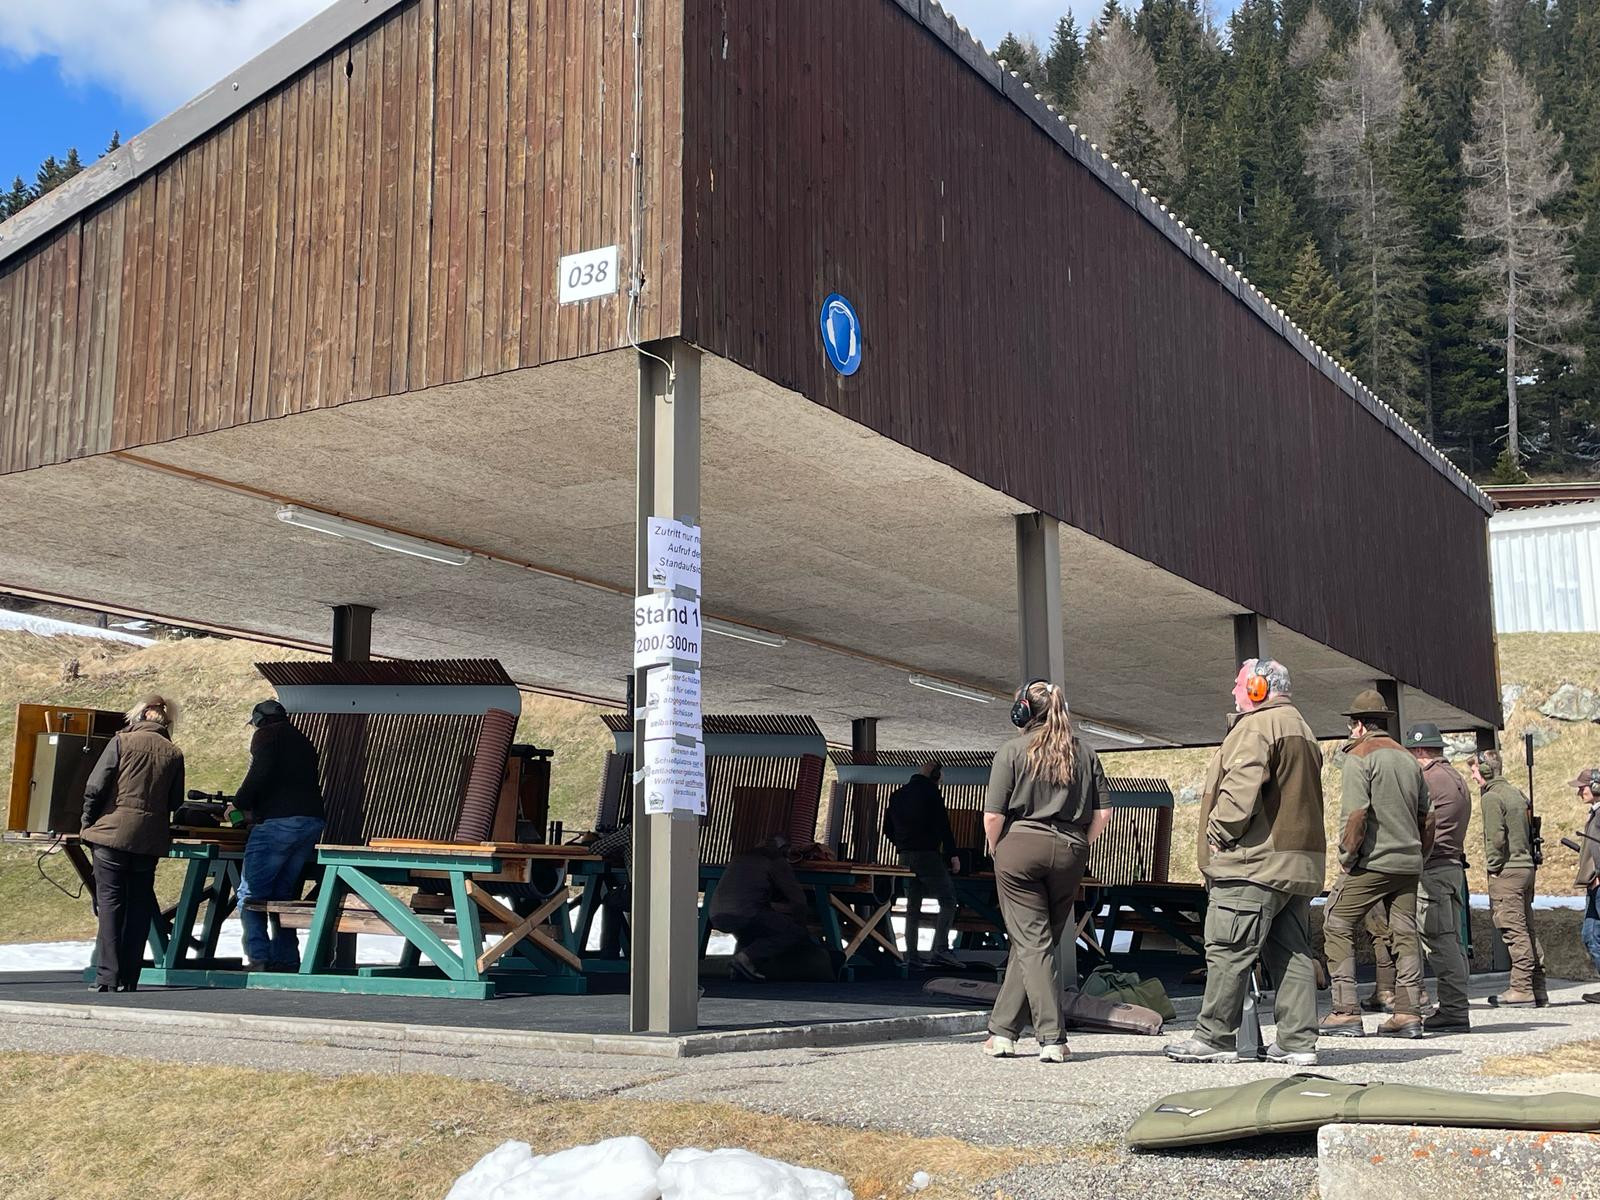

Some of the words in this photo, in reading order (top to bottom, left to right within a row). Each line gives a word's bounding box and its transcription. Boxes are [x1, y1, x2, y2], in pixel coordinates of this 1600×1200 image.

[568, 260, 609, 289] 038
[654, 525, 681, 539] Zutritt
[682, 532, 692, 542] nur
[667, 543, 690, 556] Aufruf
[691, 550, 701, 558] de
[635, 605, 688, 627] Stand
[692, 608, 699, 628] 1
[636, 634, 698, 654] 200/300m
